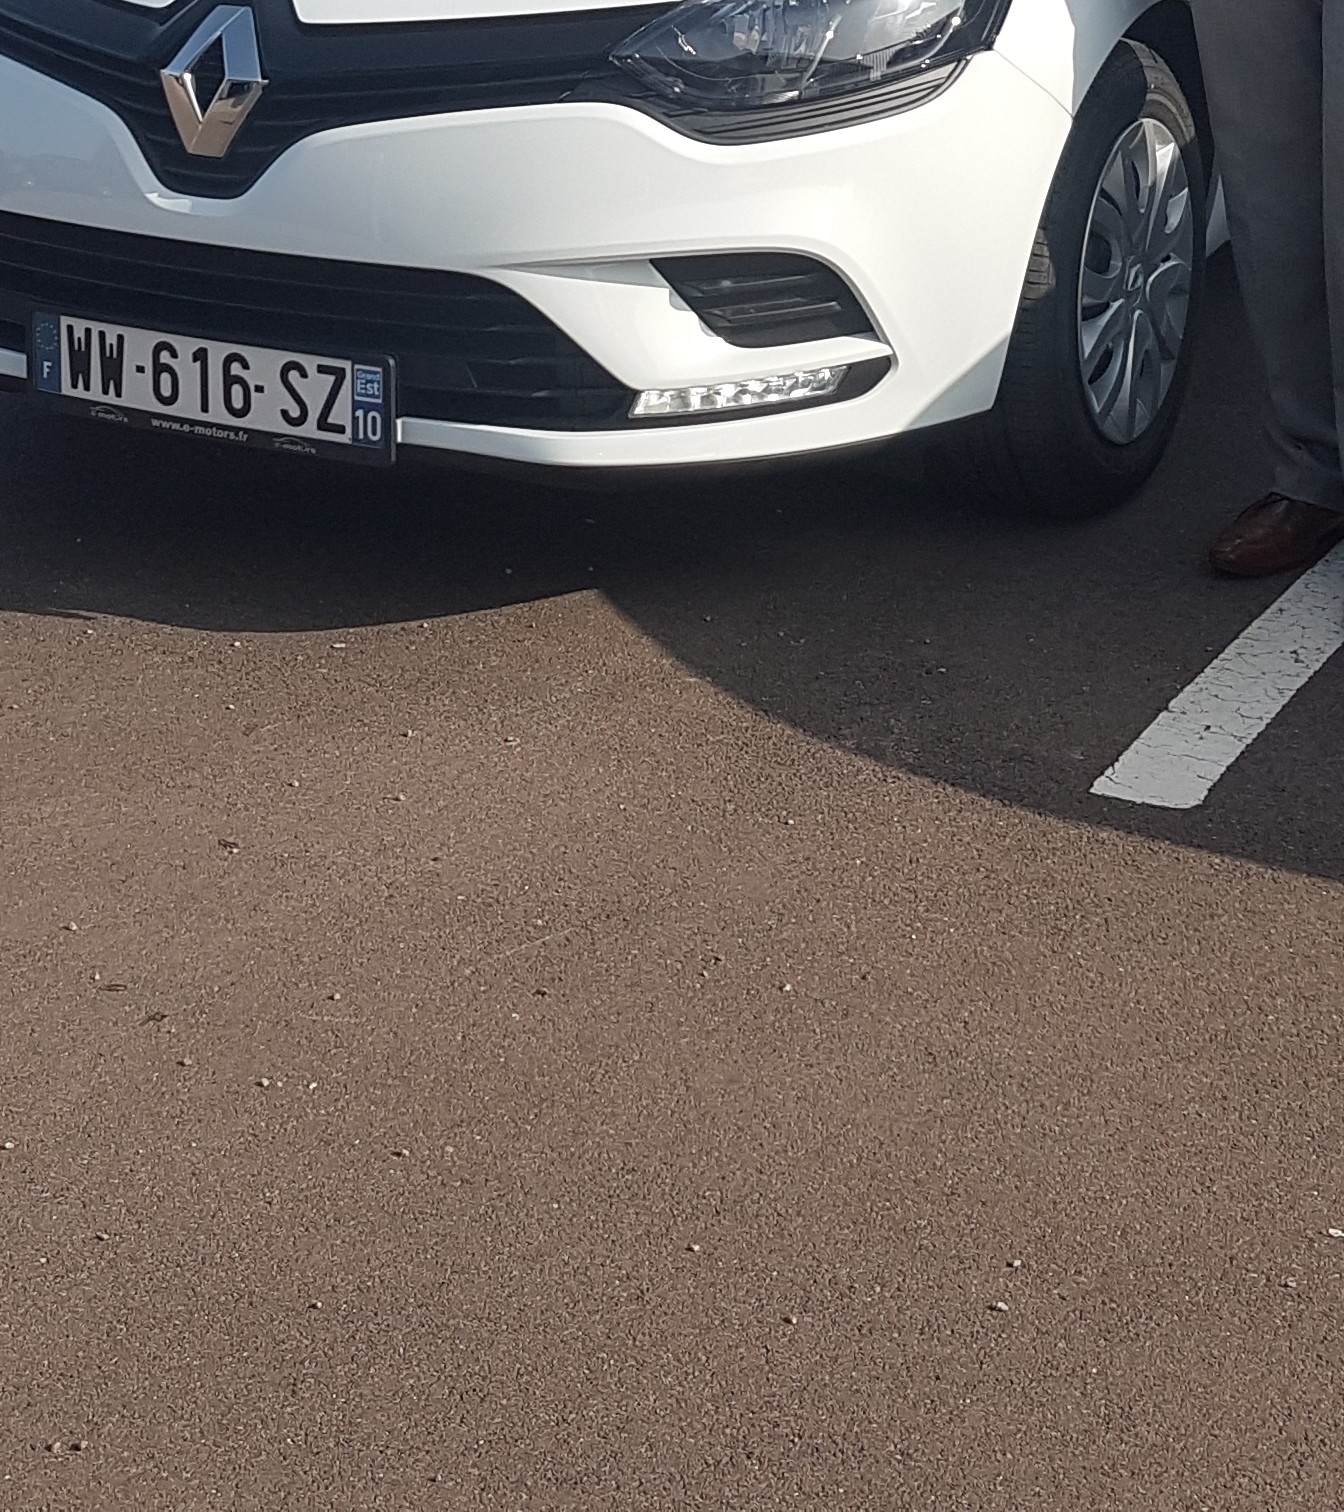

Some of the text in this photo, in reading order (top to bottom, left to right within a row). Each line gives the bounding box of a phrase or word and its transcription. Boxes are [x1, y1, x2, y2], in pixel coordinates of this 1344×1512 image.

[42, 360, 53, 379] F
[357, 379, 380, 396] Est
[150, 418, 249, 442] www.e-motors.fr
[355, 409, 382, 442] 10
